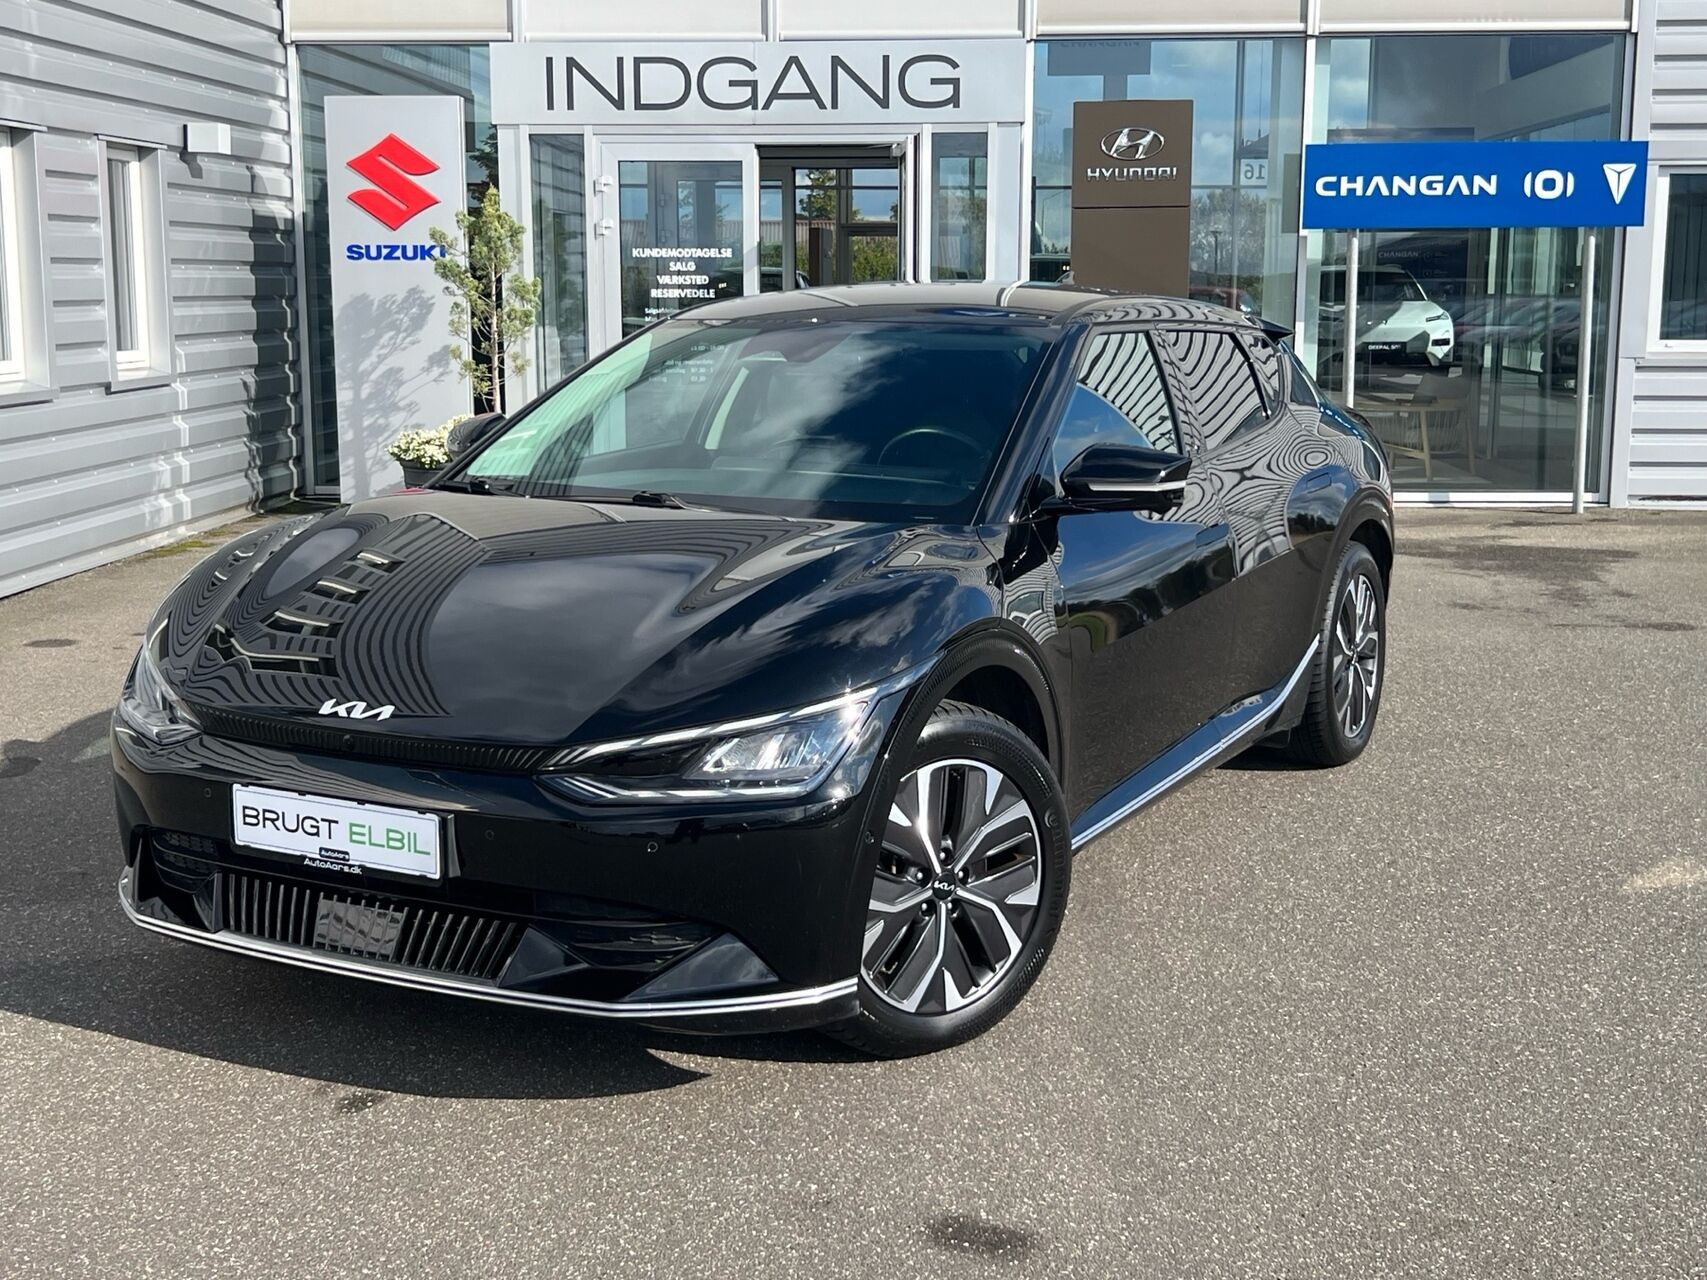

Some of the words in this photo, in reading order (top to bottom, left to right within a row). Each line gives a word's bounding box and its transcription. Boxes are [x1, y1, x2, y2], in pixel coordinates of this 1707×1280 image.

[545, 54, 961, 111] INDGANG
[1087, 166, 1178, 182] HYUNDAI
[1314, 174, 1498, 198] CHANGAN
[345, 243, 448, 261] SUZUKI
[632, 248, 733, 258] KUNDEMODTAGELSE
[669, 261, 697, 272] SALG
[656, 275, 709, 285] VÆRKSTED
[650, 288, 716, 299] RESERVEDELE
[318, 698, 396, 721] KIA
[242, 805, 340, 840] BRUGT
[349, 822, 431, 856] ELBIL
[303, 857, 363, 875] AutoAars.dk
